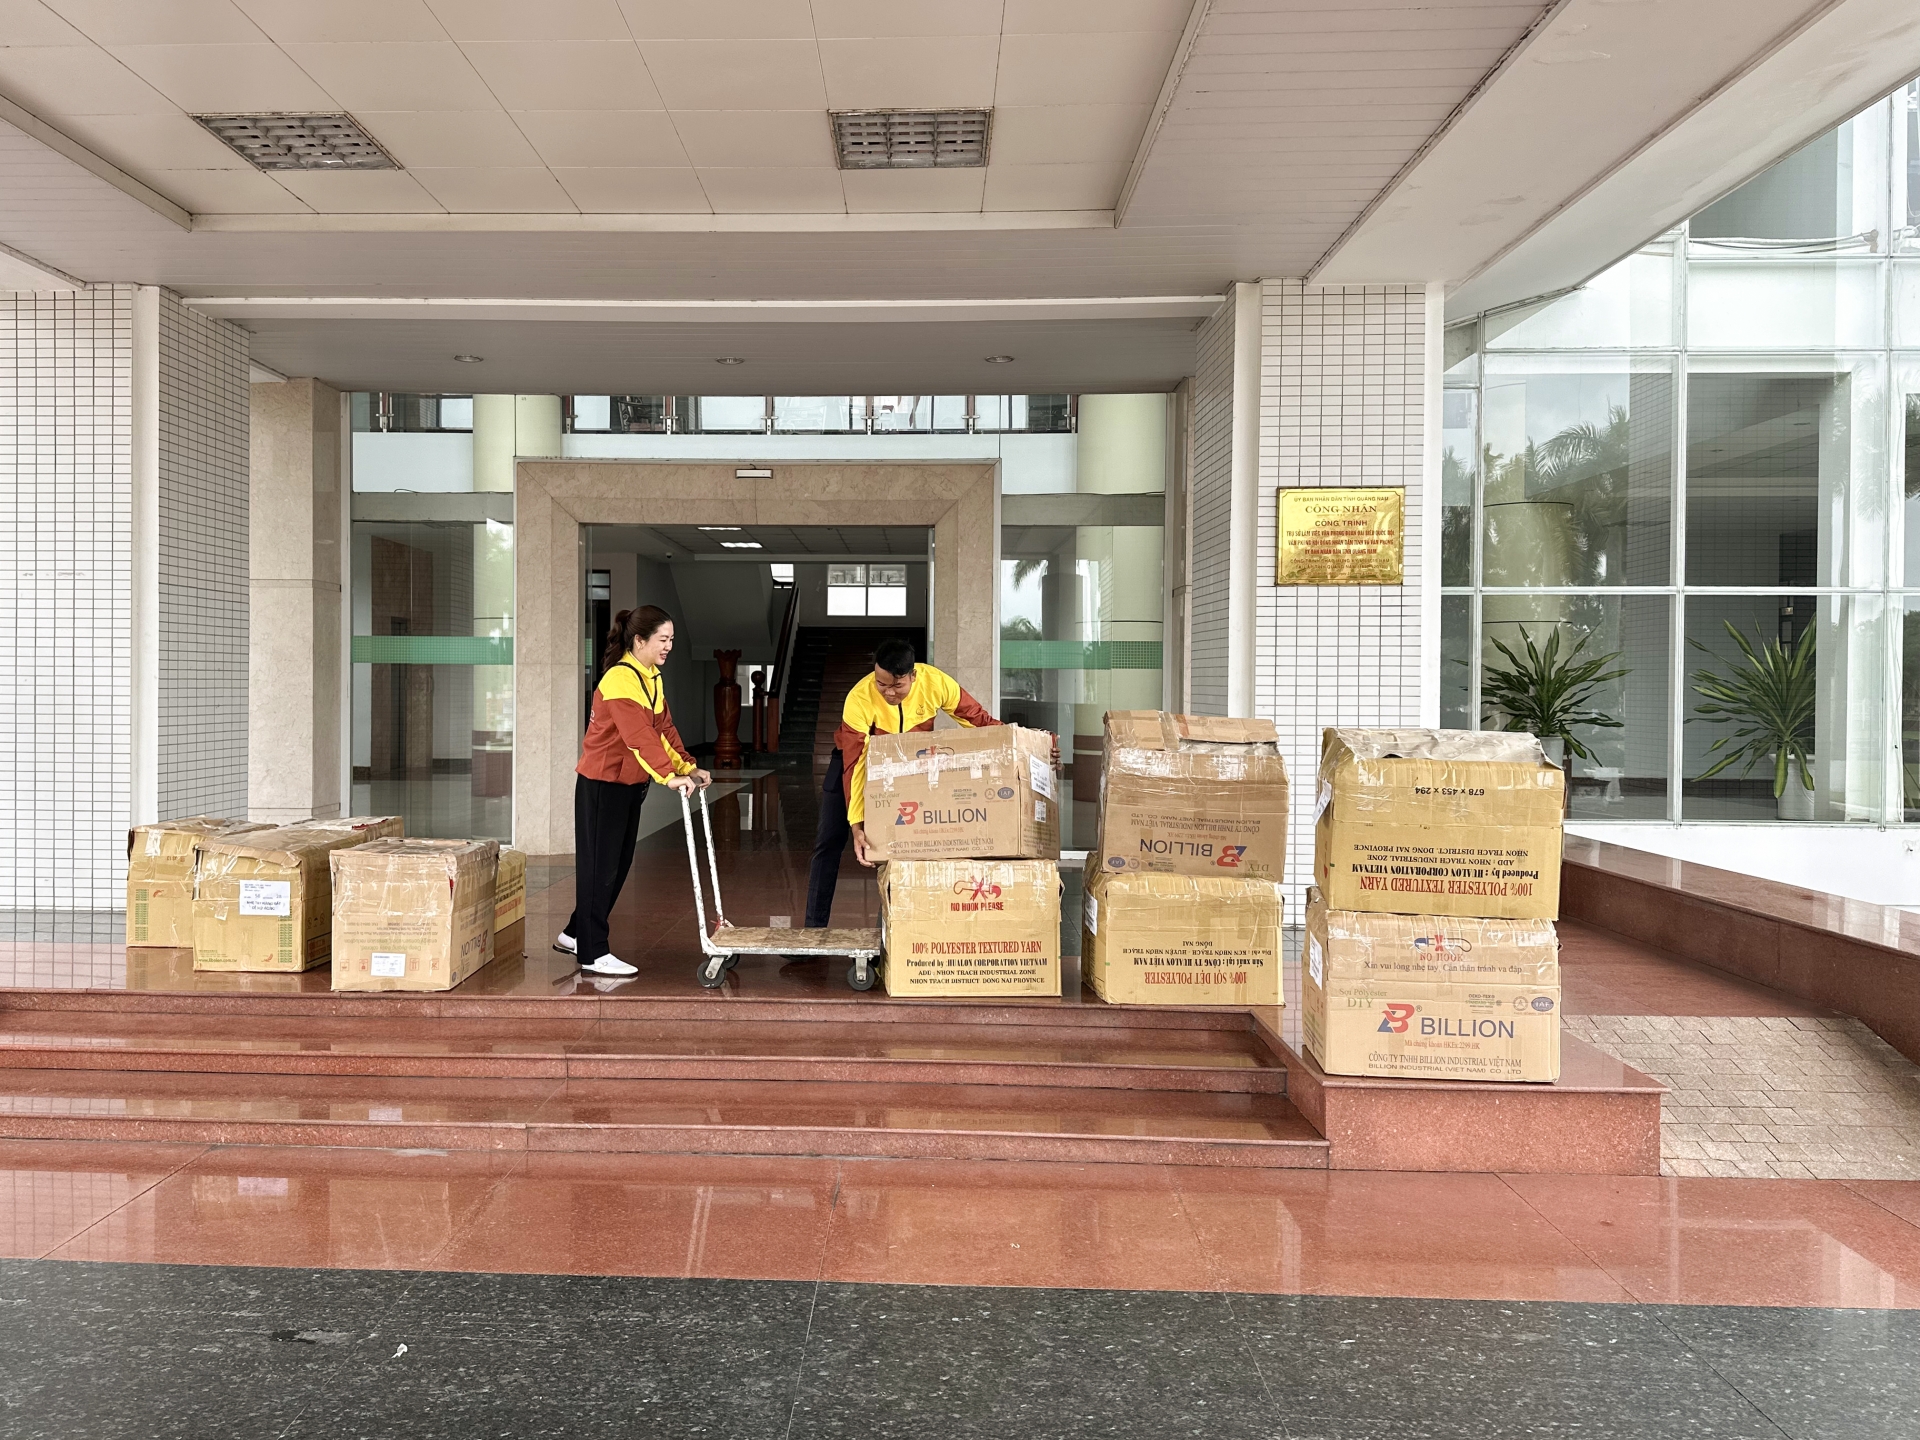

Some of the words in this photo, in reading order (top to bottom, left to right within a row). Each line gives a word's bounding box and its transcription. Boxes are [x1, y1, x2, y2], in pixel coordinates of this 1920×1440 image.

[1305, 504, 1339, 513] CÔNG
[1342, 504, 1377, 514] NHẬN
[1415, 787, 1431, 795] 294
[1442, 788, 1458, 796] 453
[1468, 788, 1485, 796] 678
[875, 800, 892, 808] DTY
[923, 808, 987, 824] BILLION
[1159, 821, 1193, 830] INDUSTRIAL
[1194, 823, 1217, 831] BILLION
[942, 839, 970, 847] INDUSTRIAL
[1140, 839, 1213, 857] BILLION
[1354, 844, 1394, 852] PROVINCE
[1367, 854, 1388, 862] ZONE
[1390, 855, 1438, 864] INDUSTRIAL
[1248, 863, 1269, 872] DTY
[1352, 863, 1388, 874] VIETNAM
[1391, 865, 1449, 876] CORPORATION
[1451, 868, 1484, 878] HUALON
[1491, 867, 1500, 879] by
[1502, 869, 1539, 880] Produced
[1360, 876, 1388, 891] YARN
[1391, 878, 1445, 894] TEXTURED
[1448, 880, 1508, 896] POLYESTER
[1510, 883, 1533, 897] 100%
[950, 903, 960, 911] NO
[961, 902, 979, 911] HOOK
[980, 902, 1004, 911] PLEASE
[912, 942, 929, 954] 100%
[930, 942, 976, 954] POLYESTER
[978, 941, 1020, 954] TEXTURED
[1020, 941, 1042, 953] YARN
[1133, 957, 1148, 966] NAM
[1150, 956, 1166, 968] VIỆT
[1166, 958, 1193, 967] HUALON
[1194, 958, 1203, 967] TY
[1420, 953, 1433, 961] NO
[1436, 953, 1464, 962] HOOK
[906, 959, 936, 967] Produced
[936, 959, 944, 968] by
[974, 959, 1018, 967] CORPORATION
[1019, 958, 1048, 966] VIETNAM
[1204, 958, 1221, 968] CÔNG
[1364, 961, 1377, 969] Xin
[1394, 963, 1410, 972] lòng
[1144, 971, 1192, 985] POLYESTER
[1194, 969, 1210, 985] DỆT
[1214, 970, 1227, 984] SỢI
[1229, 972, 1247, 984] 100%
[1354, 989, 1387, 997] Polyester
[1347, 998, 1374, 1008] DTY
[1421, 1017, 1514, 1039] BILLION
[1368, 1051, 1389, 1062] CÔNG
[1389, 1053, 1398, 1063] TY
[1399, 1054, 1419, 1064] TNHH
[1419, 1055, 1447, 1065] BILLION
[1447, 1056, 1488, 1067] INDUSTRIAL
[1489, 1056, 1505, 1068] VIỆT
[1505, 1059, 1522, 1068] NAM
[1399, 1064, 1444, 1072] INDUSTRIAL
